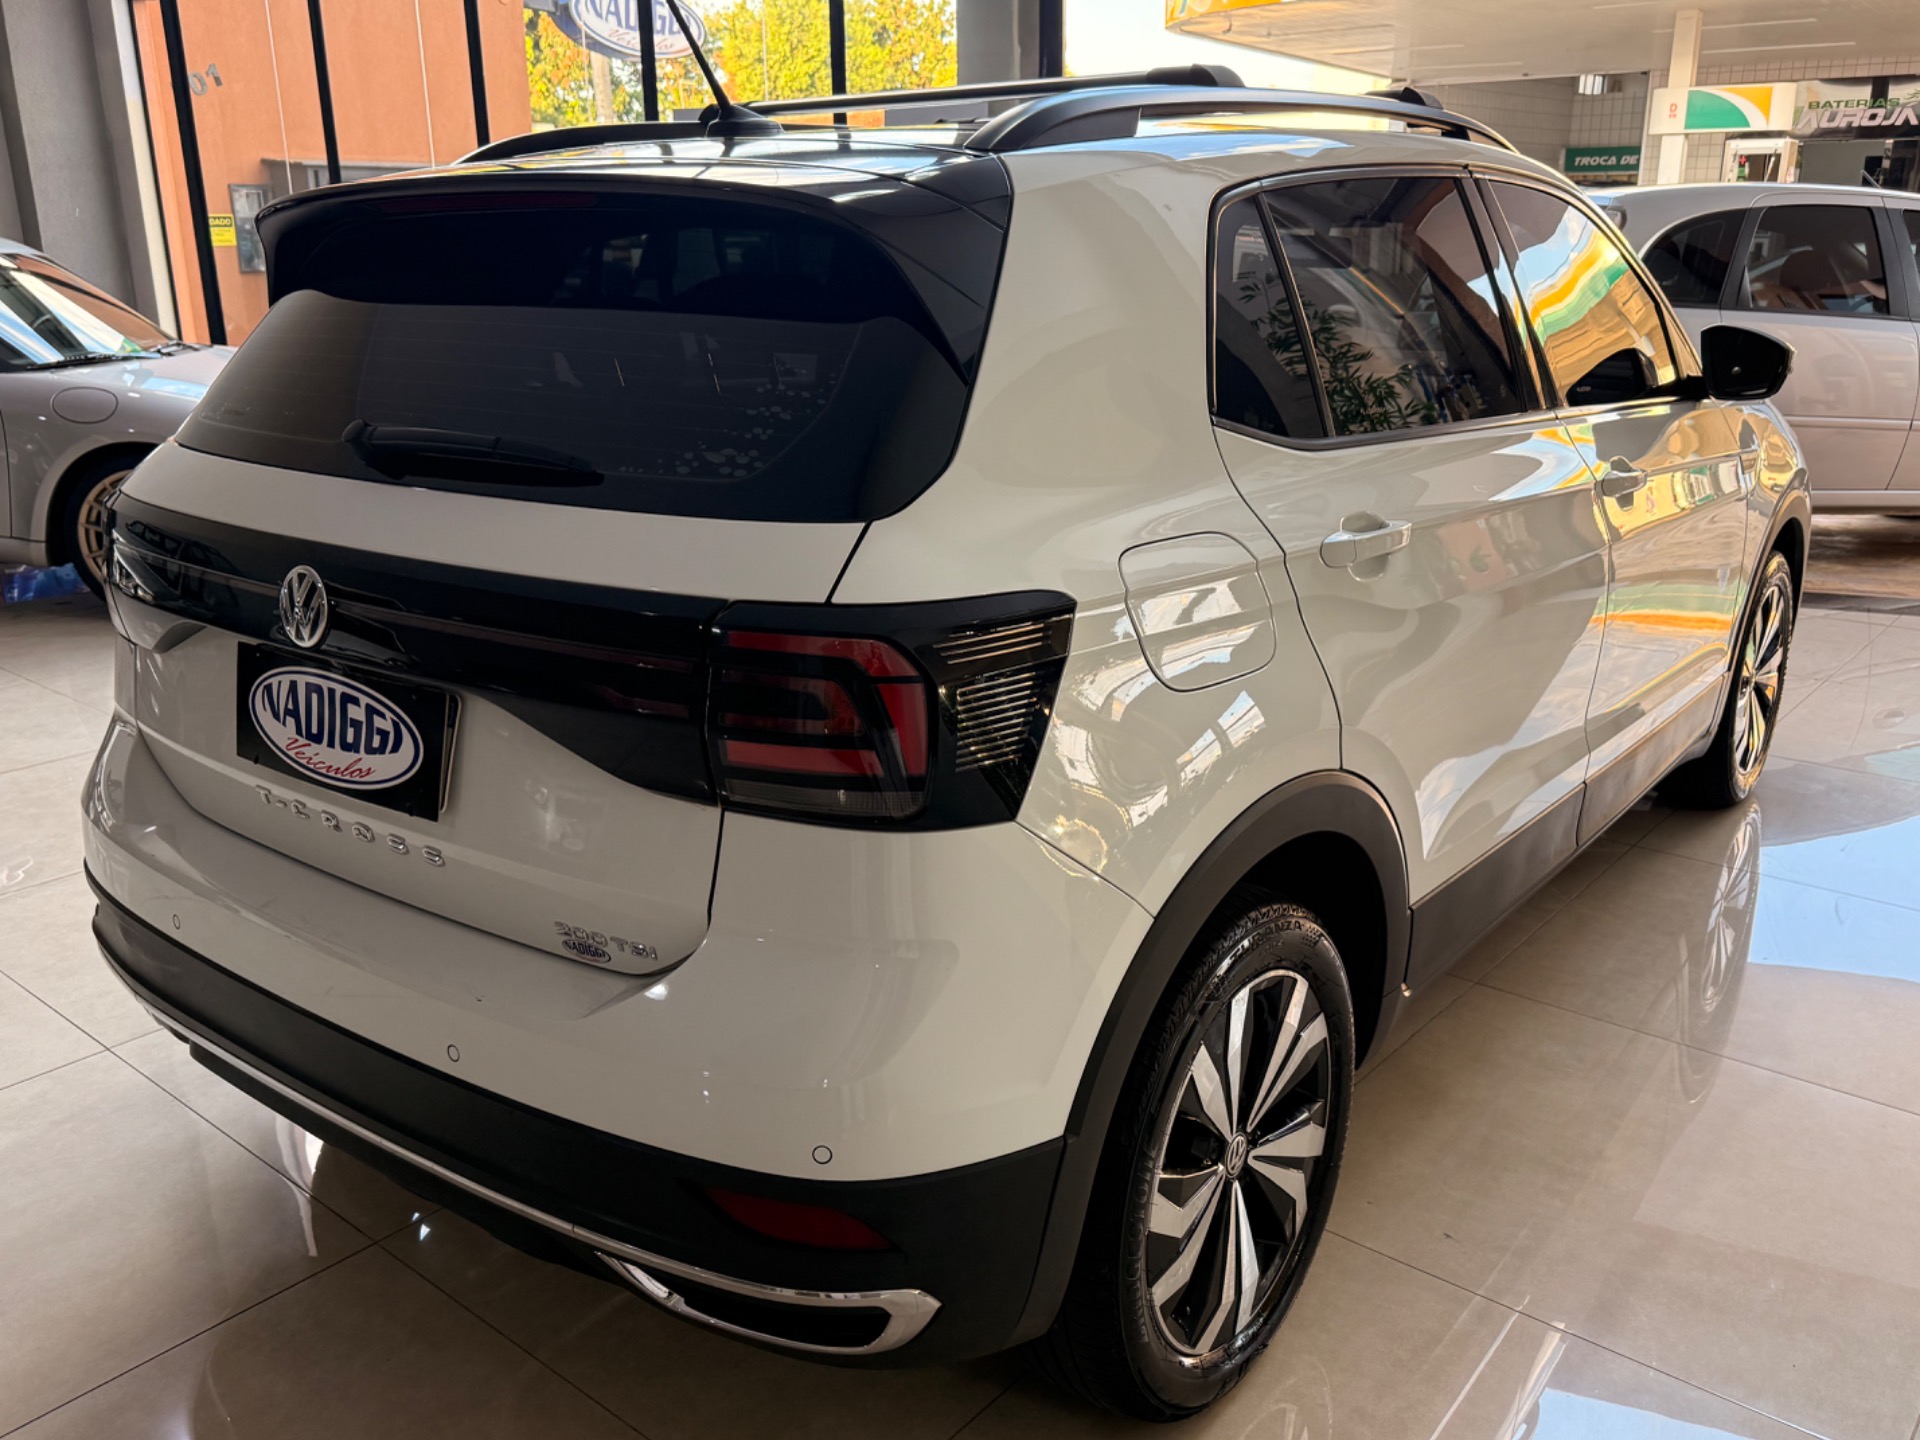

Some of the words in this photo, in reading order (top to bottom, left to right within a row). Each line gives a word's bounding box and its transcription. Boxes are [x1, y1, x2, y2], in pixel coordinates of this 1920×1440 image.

[1807, 98, 1901, 110] BATERIAS
[1574, 155, 1617, 166] TROCA
[1620, 154, 1639, 165] DE
[261, 679, 403, 755] NADIGGI
